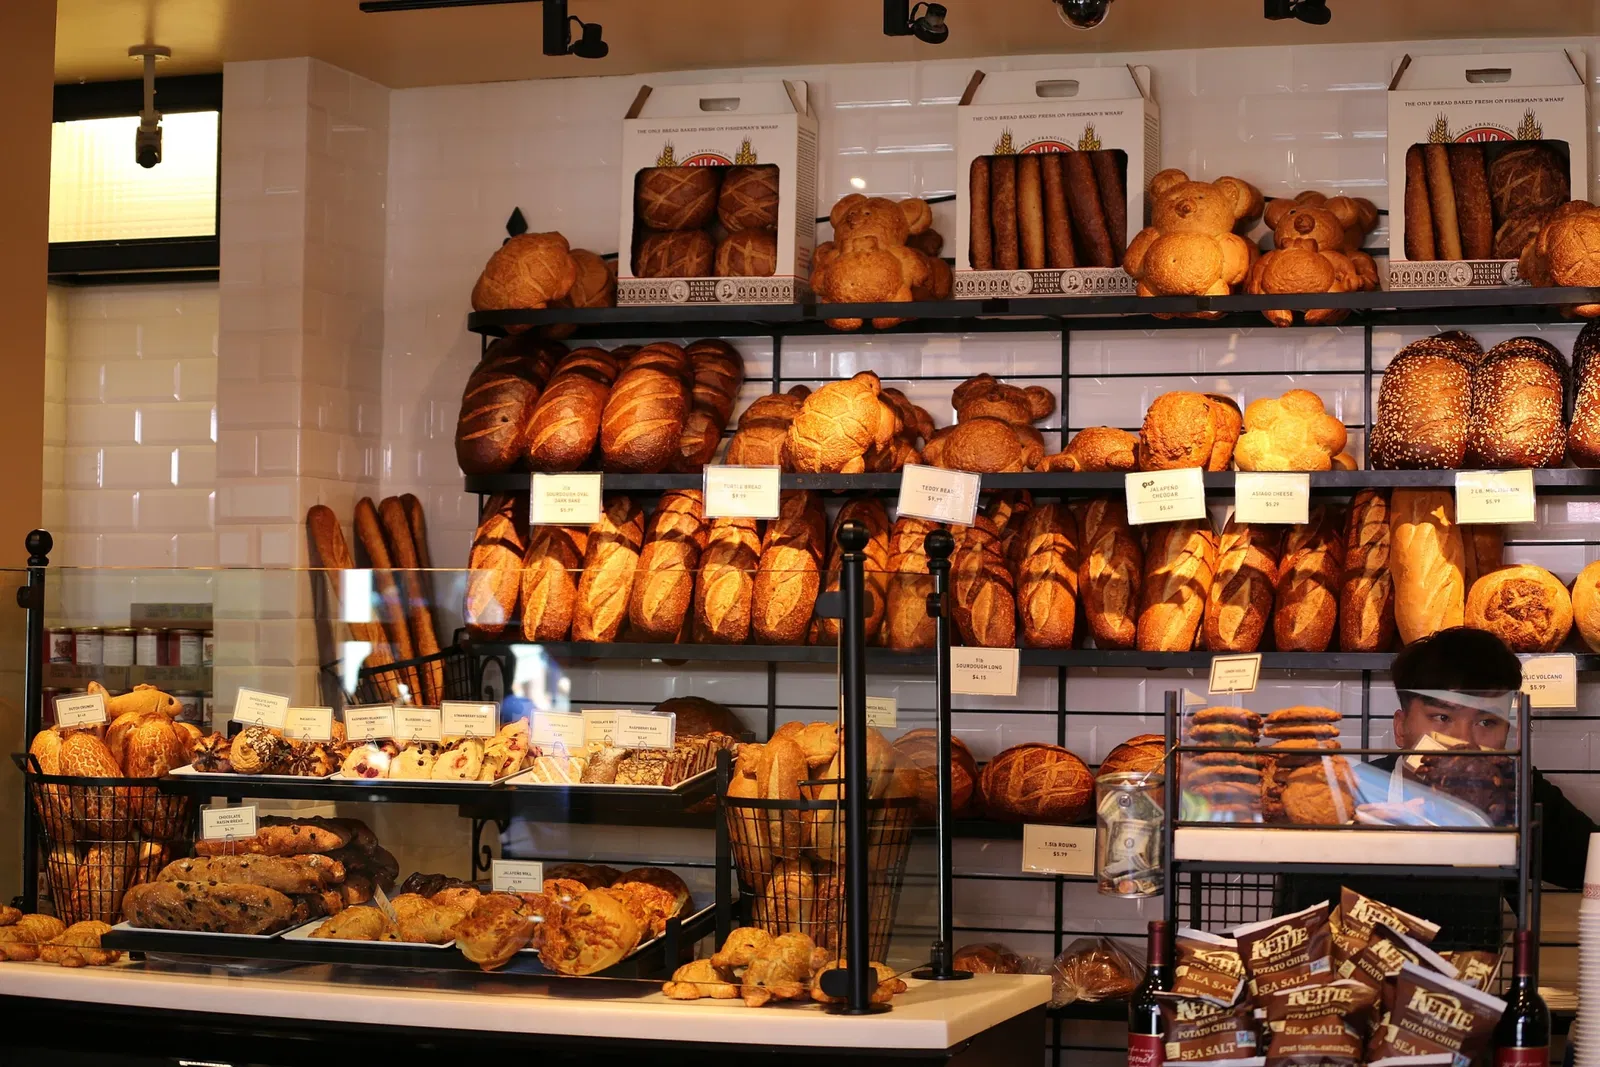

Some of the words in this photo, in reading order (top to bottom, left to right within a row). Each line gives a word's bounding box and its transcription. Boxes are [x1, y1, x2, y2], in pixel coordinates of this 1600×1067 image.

[1474, 121, 1514, 134] FRANCISCO
[922, 484, 940, 492] TEDDY
[1252, 925, 1309, 959] KETTLE
[1253, 962, 1286, 976] POTATO
[1286, 953, 1310, 967] CHIPS
[1270, 951, 1291, 963] BRAND
[1358, 958, 1384, 981] POTATO
[1186, 972, 1209, 986] SEA
[1211, 980, 1235, 993] SAL
[1259, 981, 1279, 996] SEA
[1281, 973, 1310, 988] SALT
[1285, 986, 1354, 1006] KETTLE
[1405, 985, 1474, 1032] KETTLE
[1178, 1027, 1210, 1039] POTATO
[1211, 1021, 1237, 1032] CHIPS
[1285, 1026, 1308, 1035] SEA
[1311, 1025, 1344, 1035] SALT
[1400, 1018, 1435, 1038] POTATO
[1435, 1034, 1462, 1050] CHIPS
[1181, 1049, 1203, 1060] SEA
[1206, 1042, 1236, 1056] SALT
[1393, 1039, 1417, 1056] SEA
